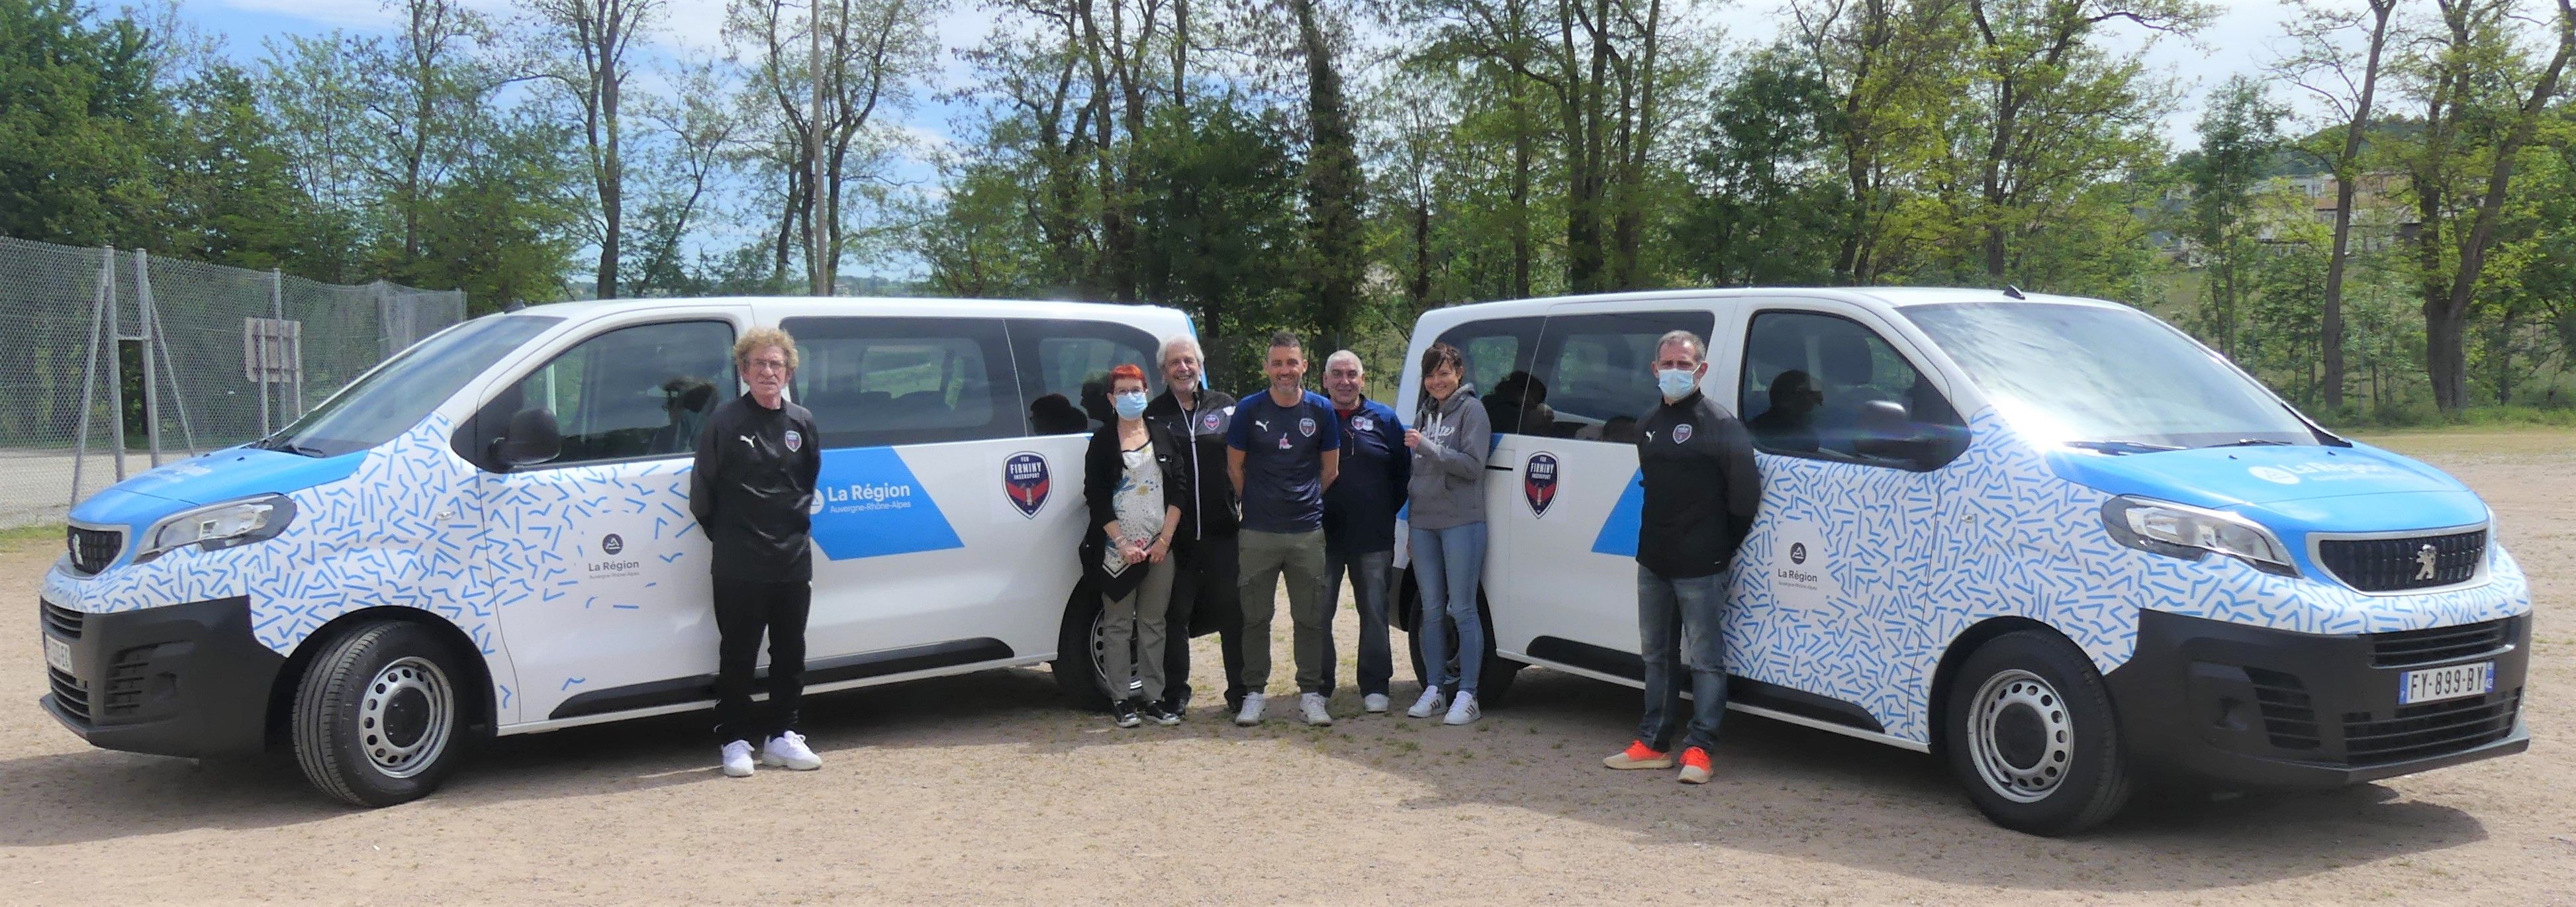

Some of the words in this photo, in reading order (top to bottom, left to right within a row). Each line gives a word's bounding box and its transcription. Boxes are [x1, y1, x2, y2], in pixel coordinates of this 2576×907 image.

[1010, 462, 1041, 474] FIRMINY
[2277, 463, 2320, 474] La
[828, 487, 847, 502] La
[851, 482, 910, 502] Région
[830, 501, 912, 514] Auvergne-Rhône-Alpes
[589, 563, 600, 571] La
[603, 560, 640, 571] Région
[1778, 568, 1788, 578] La
[1789, 570, 1817, 583] Région
[2410, 667, 2483, 699] FY-899-BY
